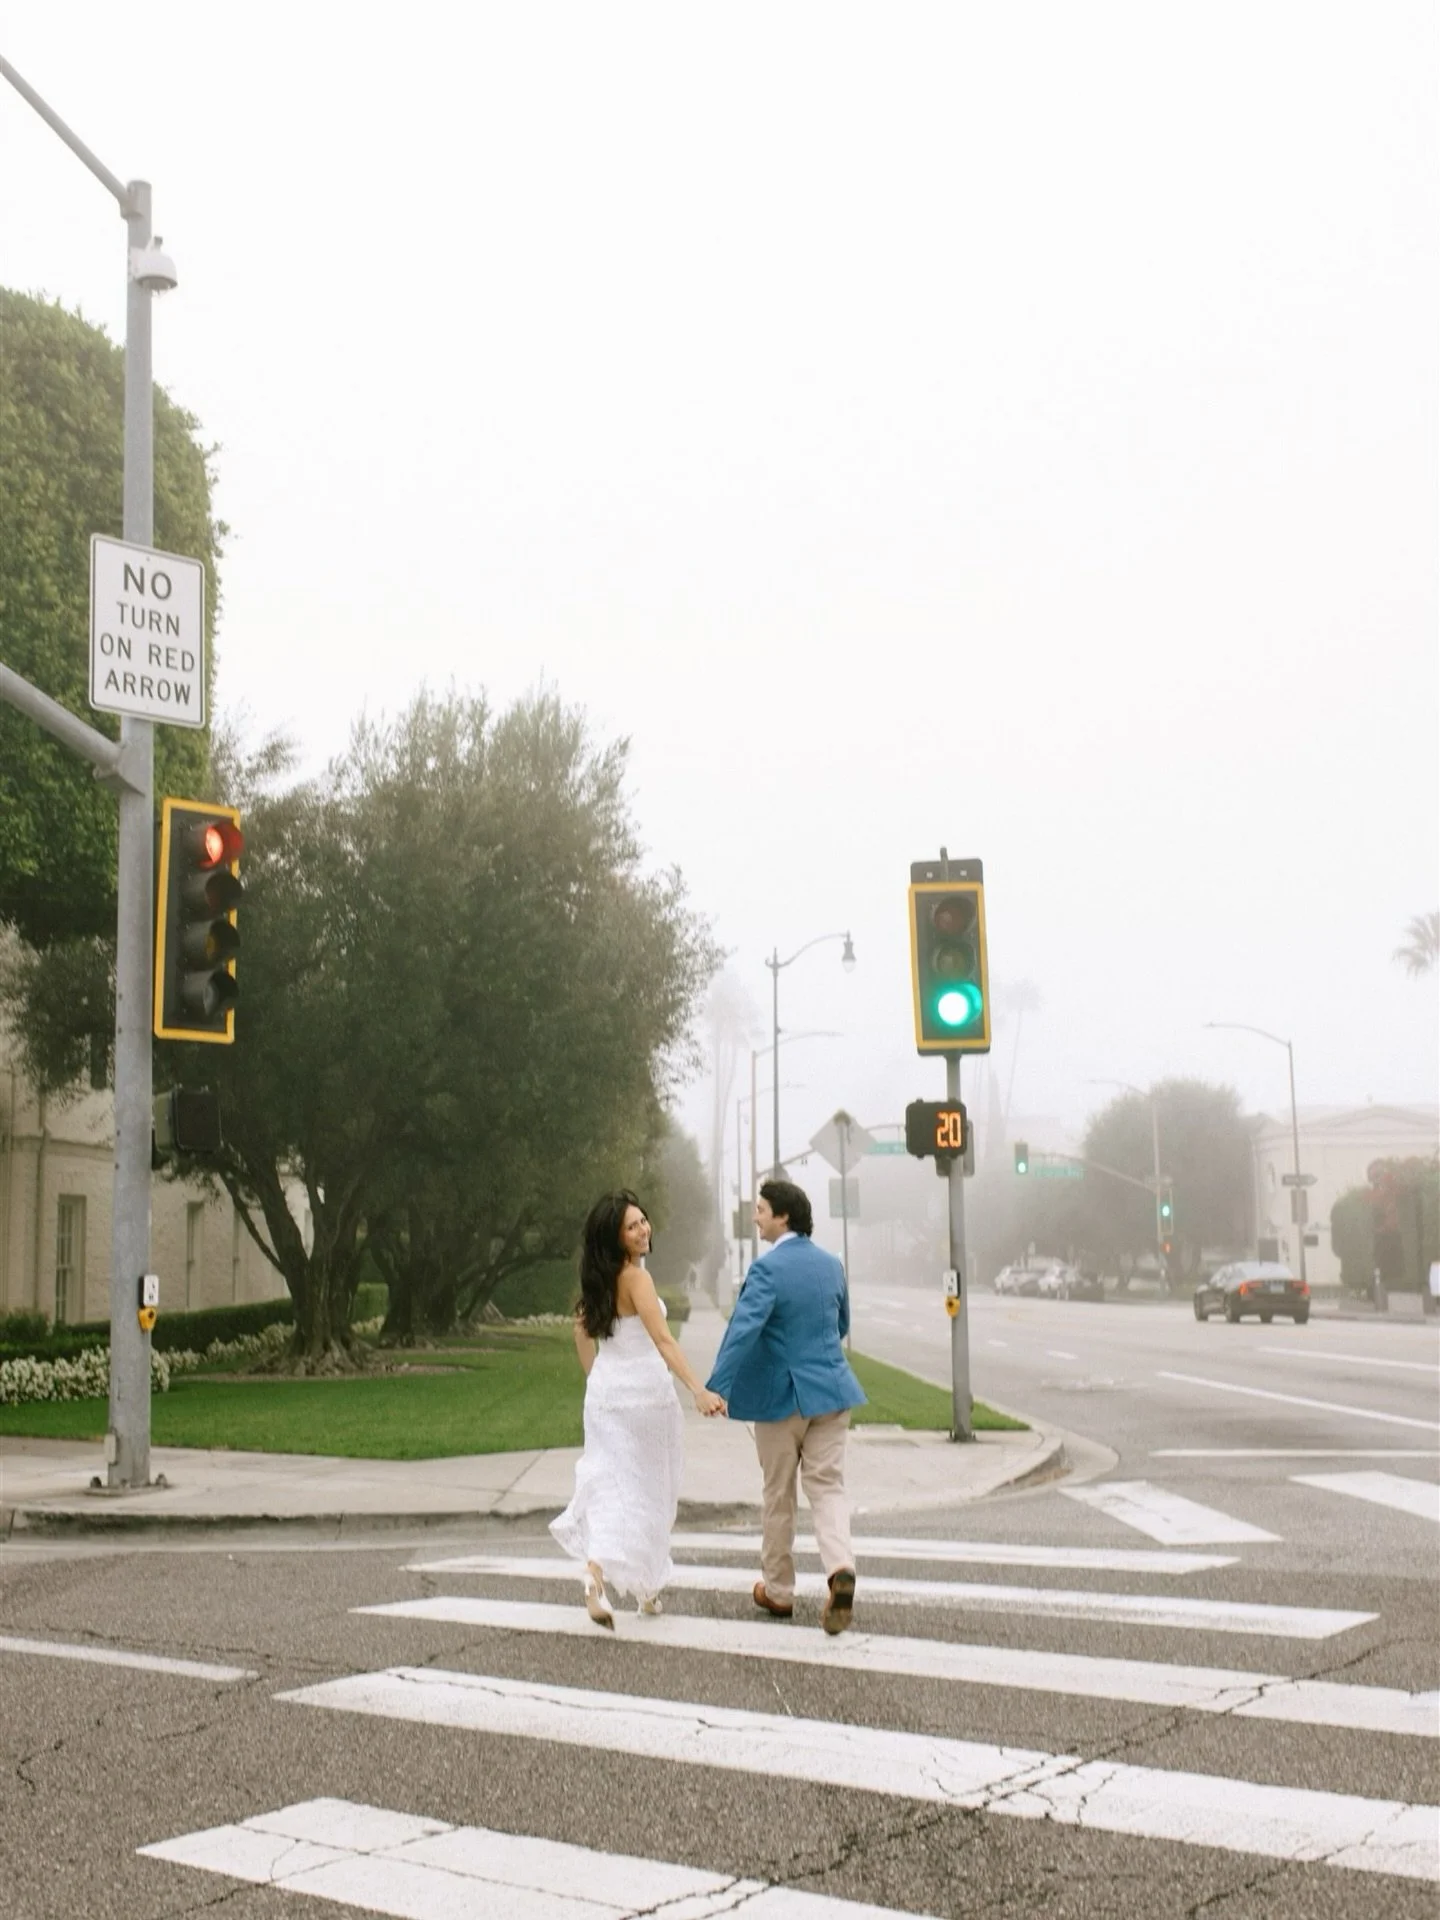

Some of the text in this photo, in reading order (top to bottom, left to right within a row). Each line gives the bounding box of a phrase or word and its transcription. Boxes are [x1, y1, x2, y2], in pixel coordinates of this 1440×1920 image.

[123, 562, 172, 601] NO
[116, 601, 180, 637] TURN
[99, 632, 195, 673] ON RED
[104, 668, 191, 706] ARROW
[936, 1111, 962, 1148] 20
